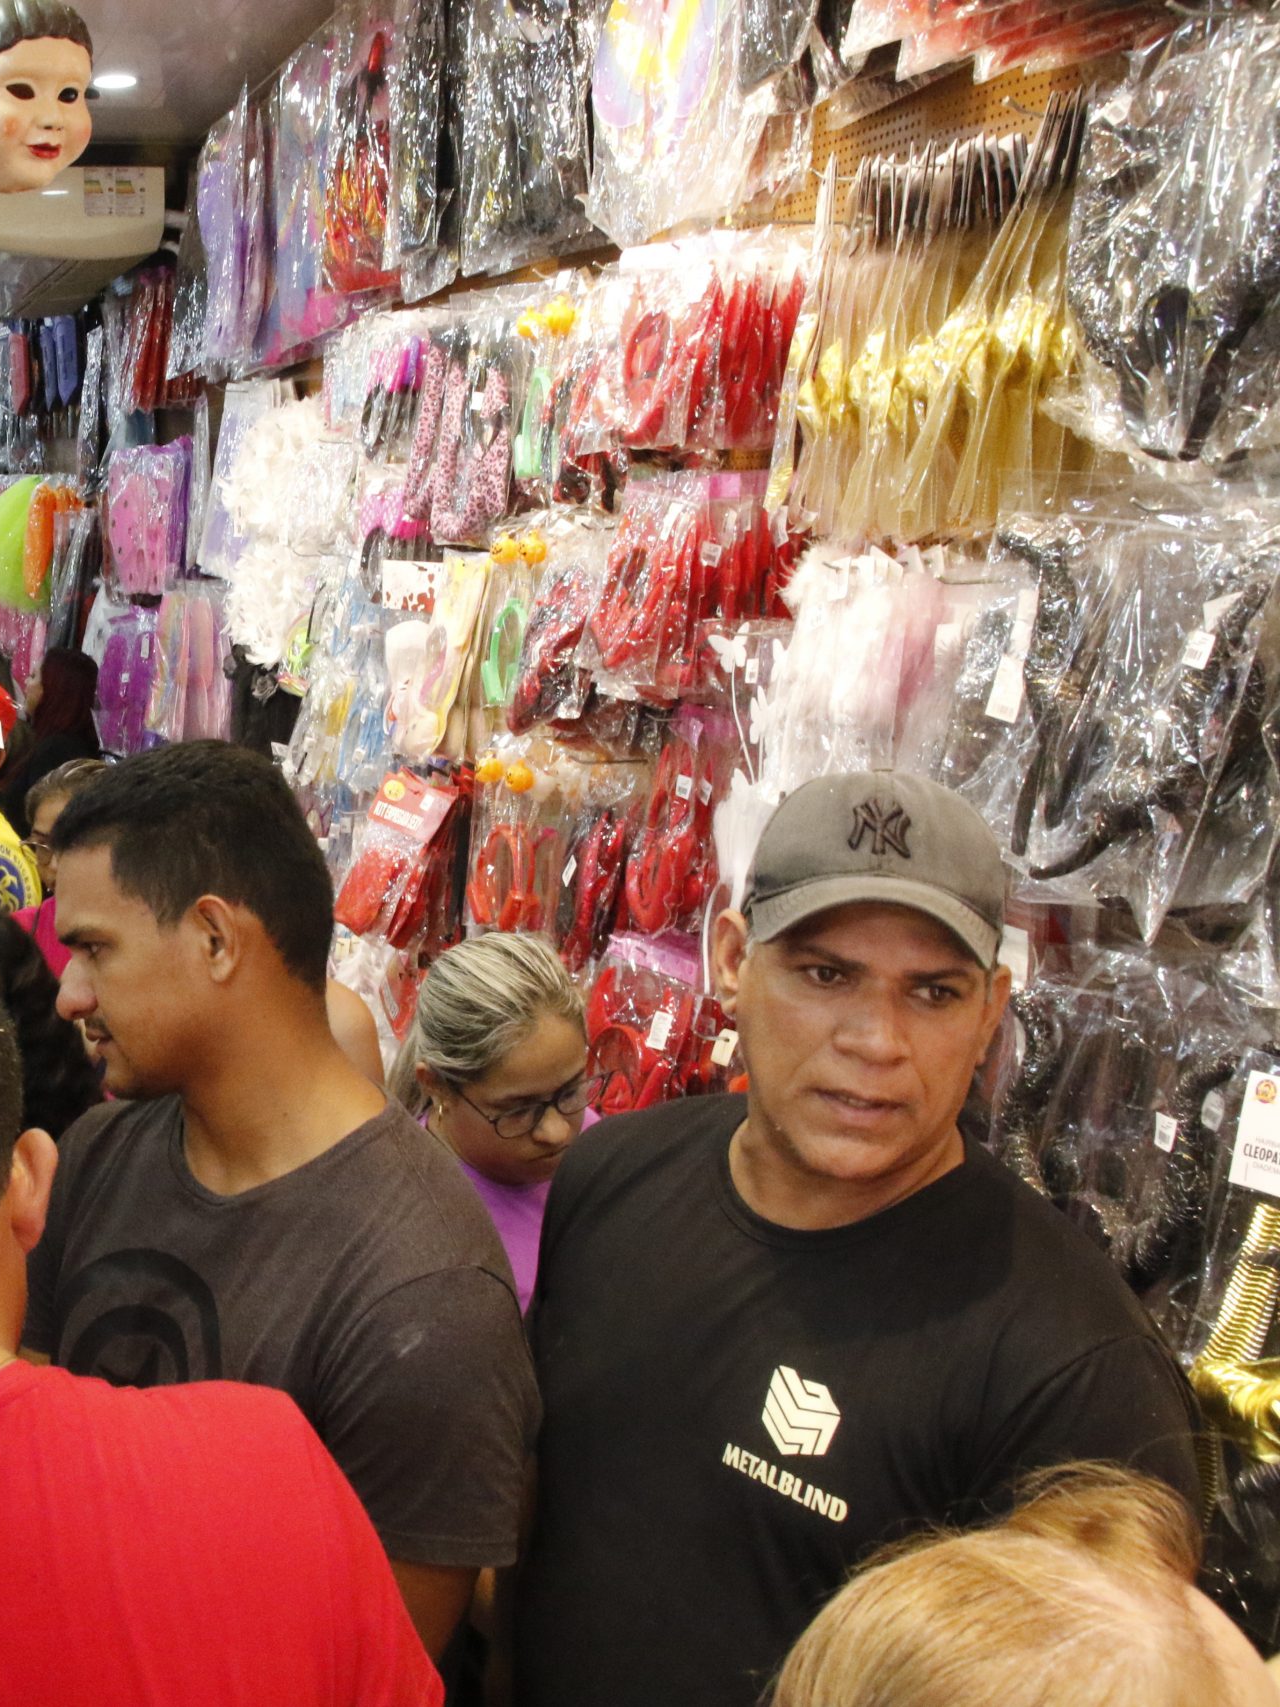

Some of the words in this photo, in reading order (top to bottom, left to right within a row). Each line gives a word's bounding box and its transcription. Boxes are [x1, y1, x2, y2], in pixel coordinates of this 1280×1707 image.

[848, 798, 911, 859] NY
[1243, 1143, 1280, 1165] CLEOPA
[722, 1443, 848, 1522] METALBLIND
